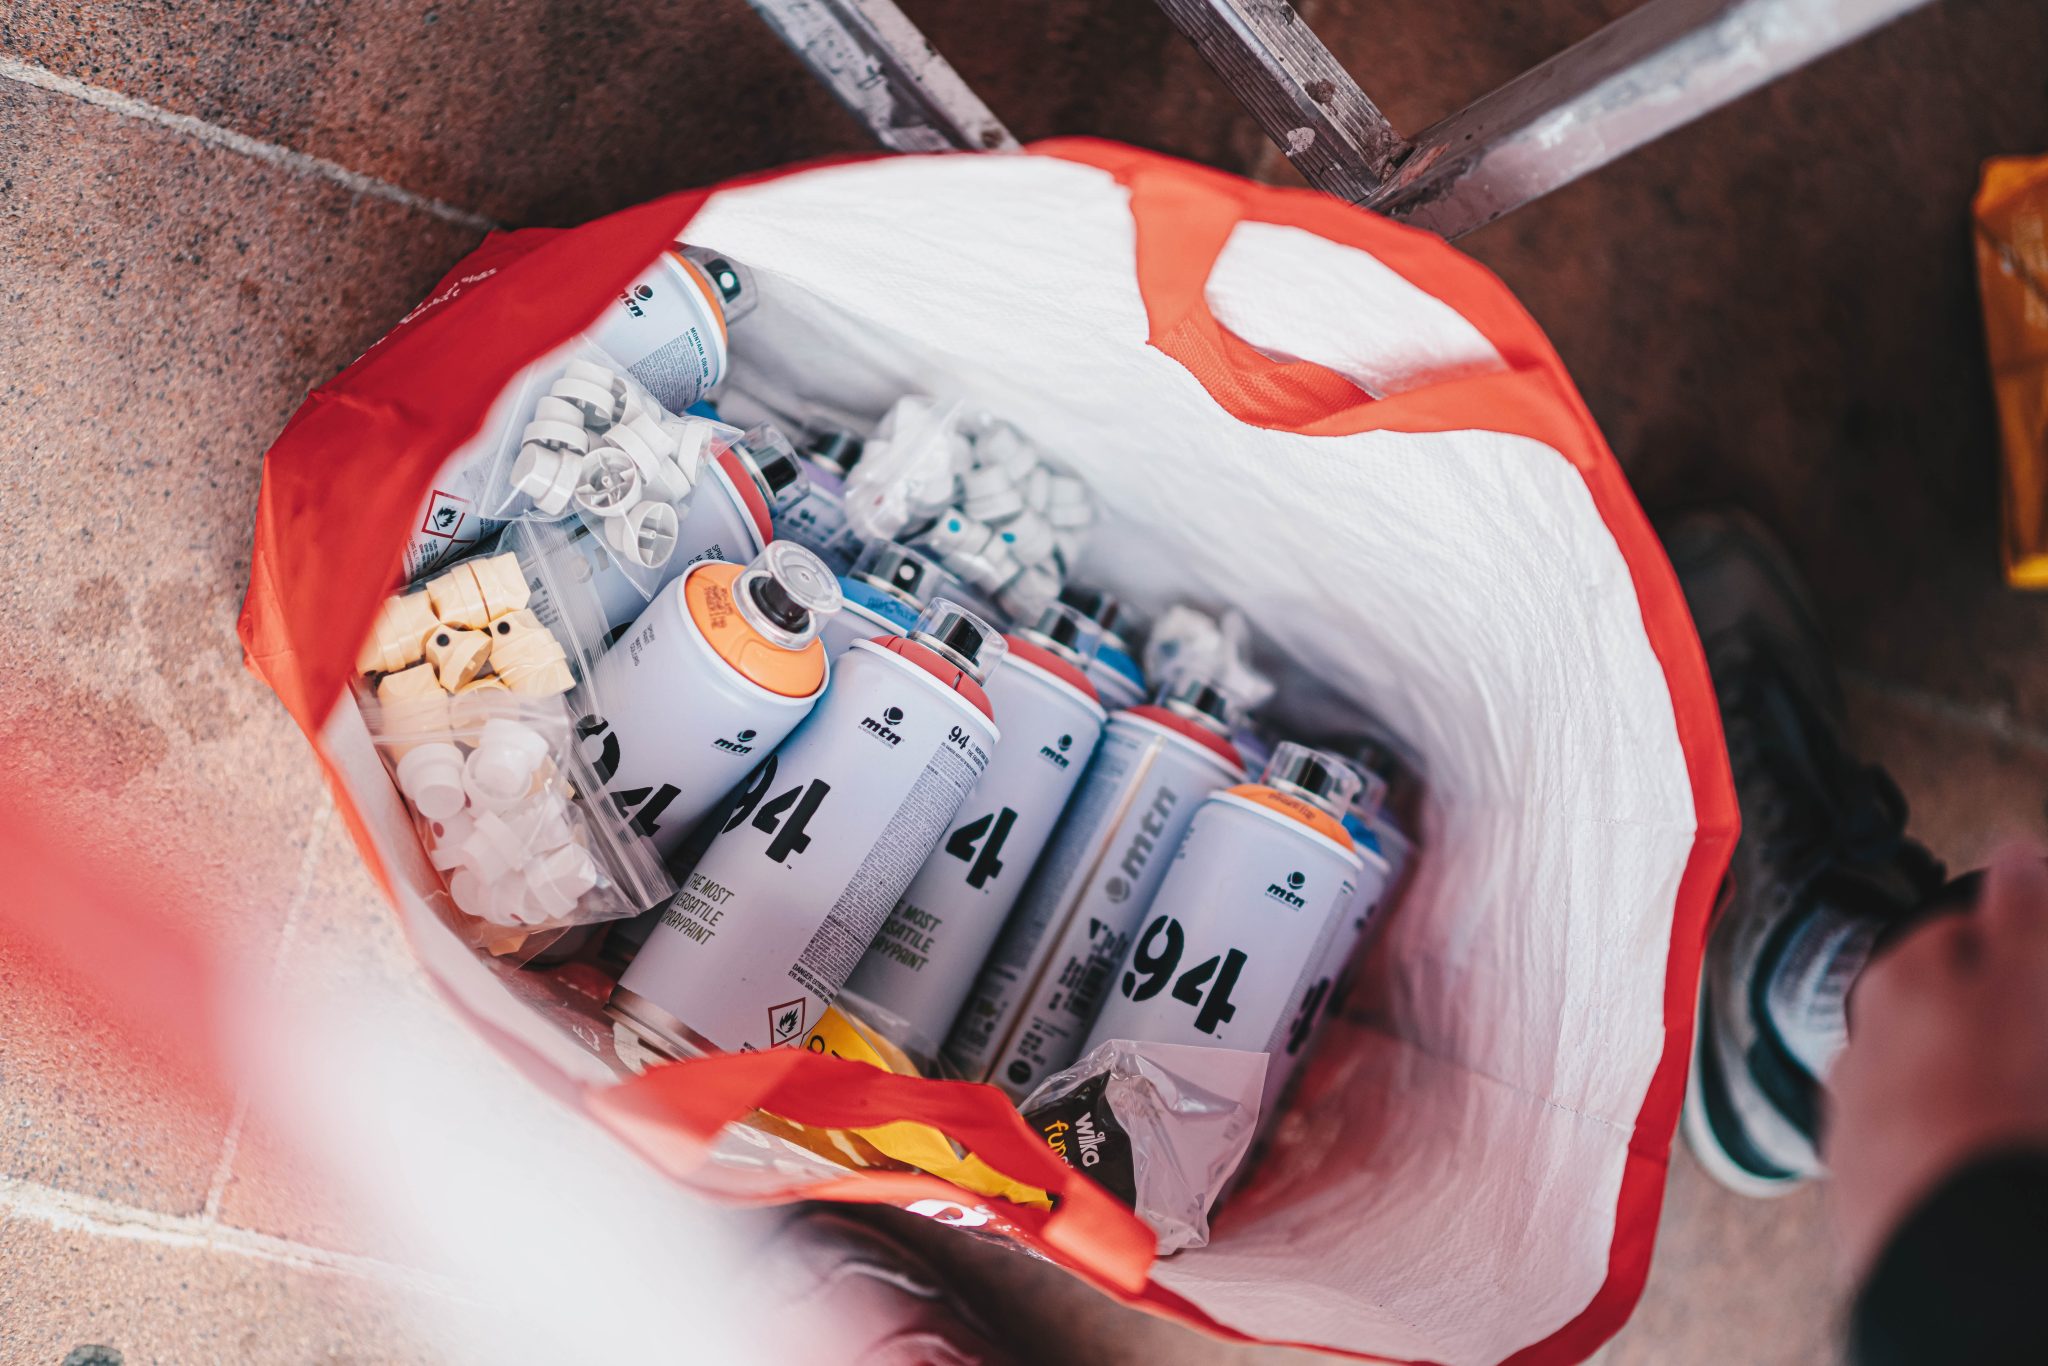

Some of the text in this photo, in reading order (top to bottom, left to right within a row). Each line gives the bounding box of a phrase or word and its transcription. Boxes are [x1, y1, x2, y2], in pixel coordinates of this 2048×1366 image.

[861, 716, 902, 746] mtn
[948, 725, 970, 749] 94
[713, 738, 753, 754] mtn
[1040, 746, 1070, 768] mtn
[1121, 786, 1177, 880] mtn
[689, 872, 735, 905] THE MOST
[1266, 884, 1305, 908] mtn
[901, 904, 943, 933] MOST
[1122, 915, 1248, 1035] 94
[1075, 1112, 1106, 1167] wilko
